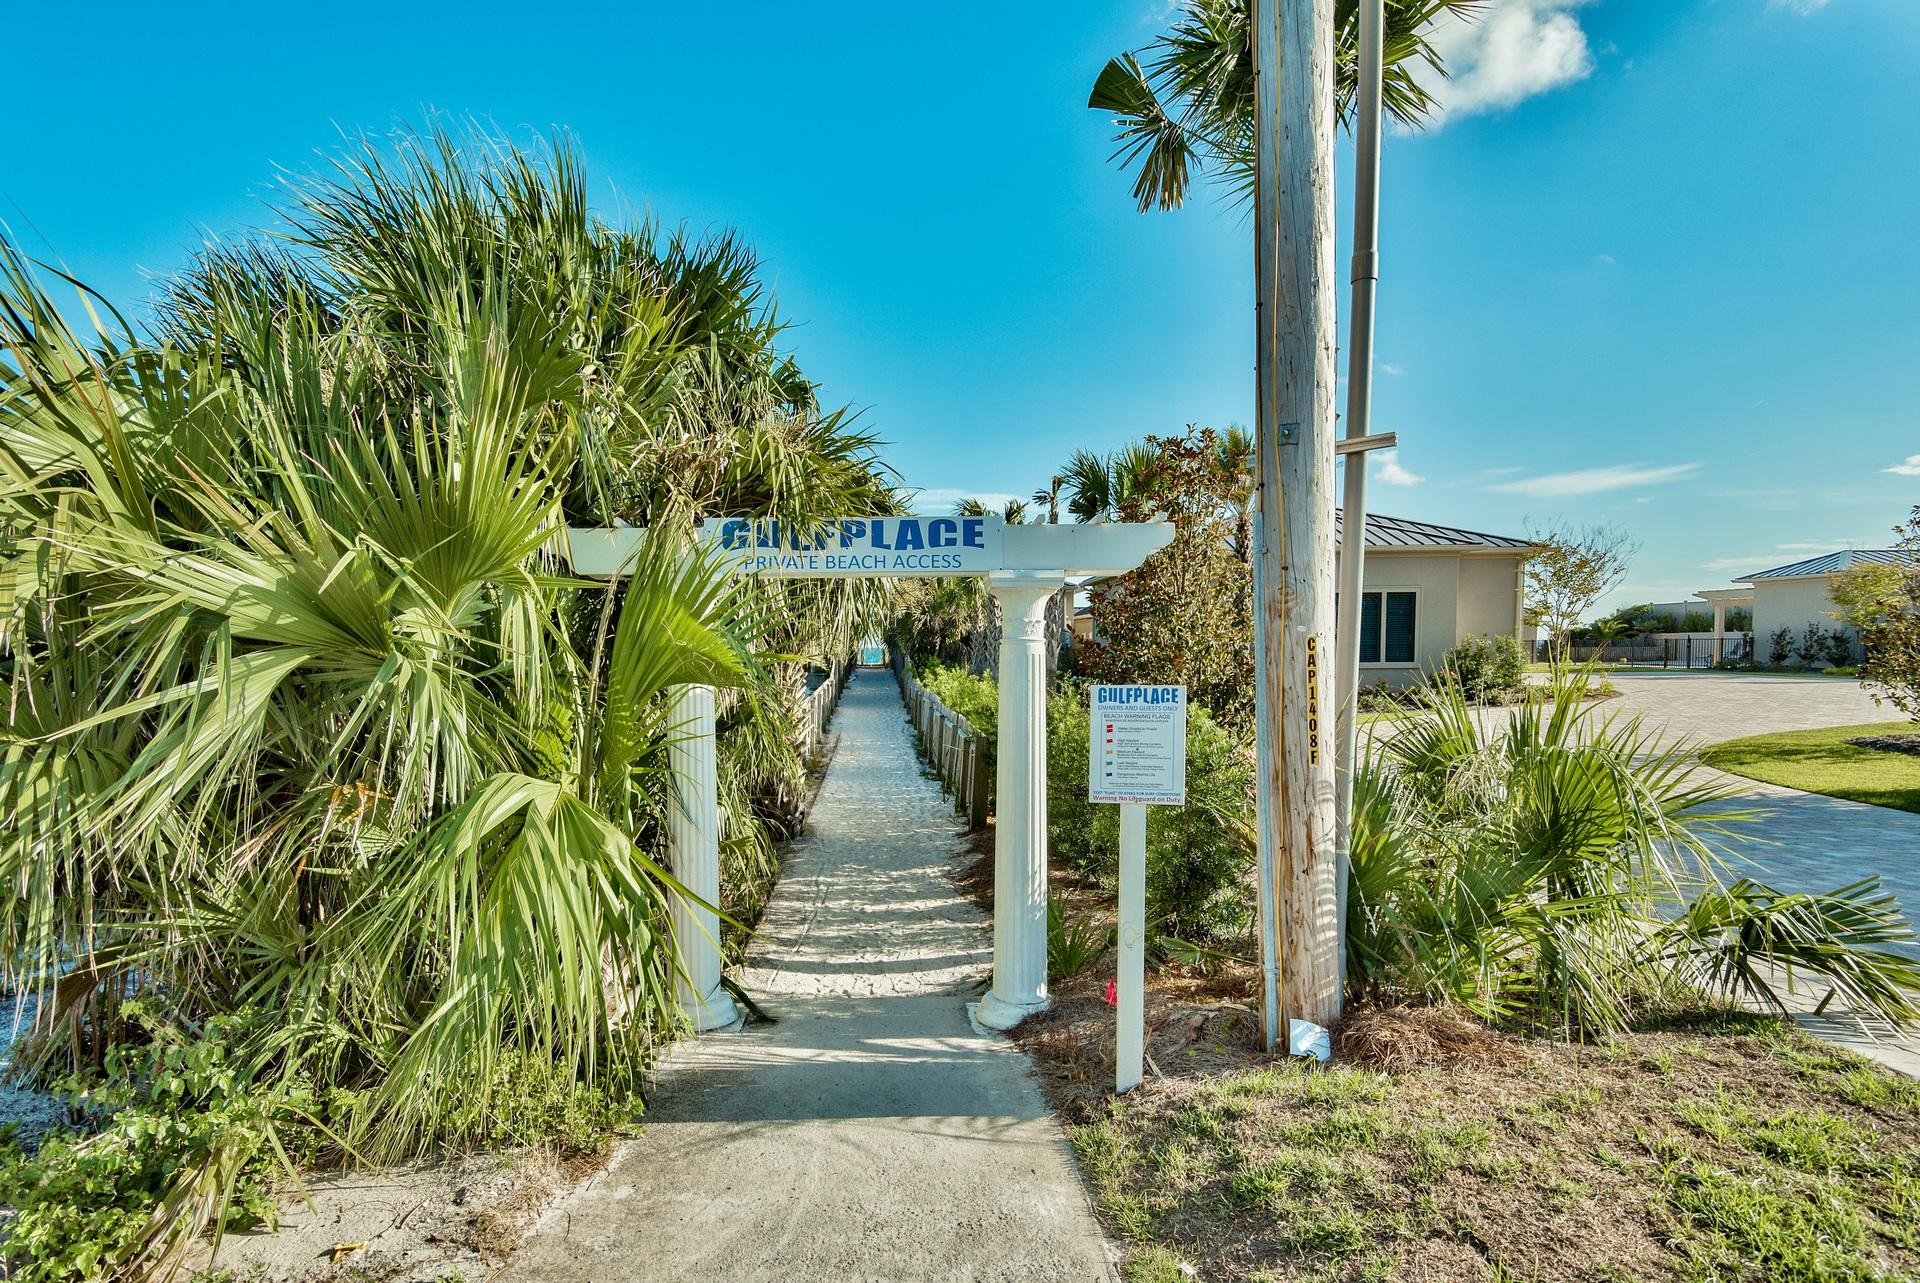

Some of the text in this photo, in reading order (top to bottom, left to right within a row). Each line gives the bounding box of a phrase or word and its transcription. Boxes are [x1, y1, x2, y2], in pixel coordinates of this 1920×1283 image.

[722, 518, 985, 551] GULFPLACE
[745, 554, 962, 569] PRIVATE BEACH ACCESS
[1098, 686, 1179, 704] GULFPLACE
[1307, 637, 1318, 765] CAP1408F
